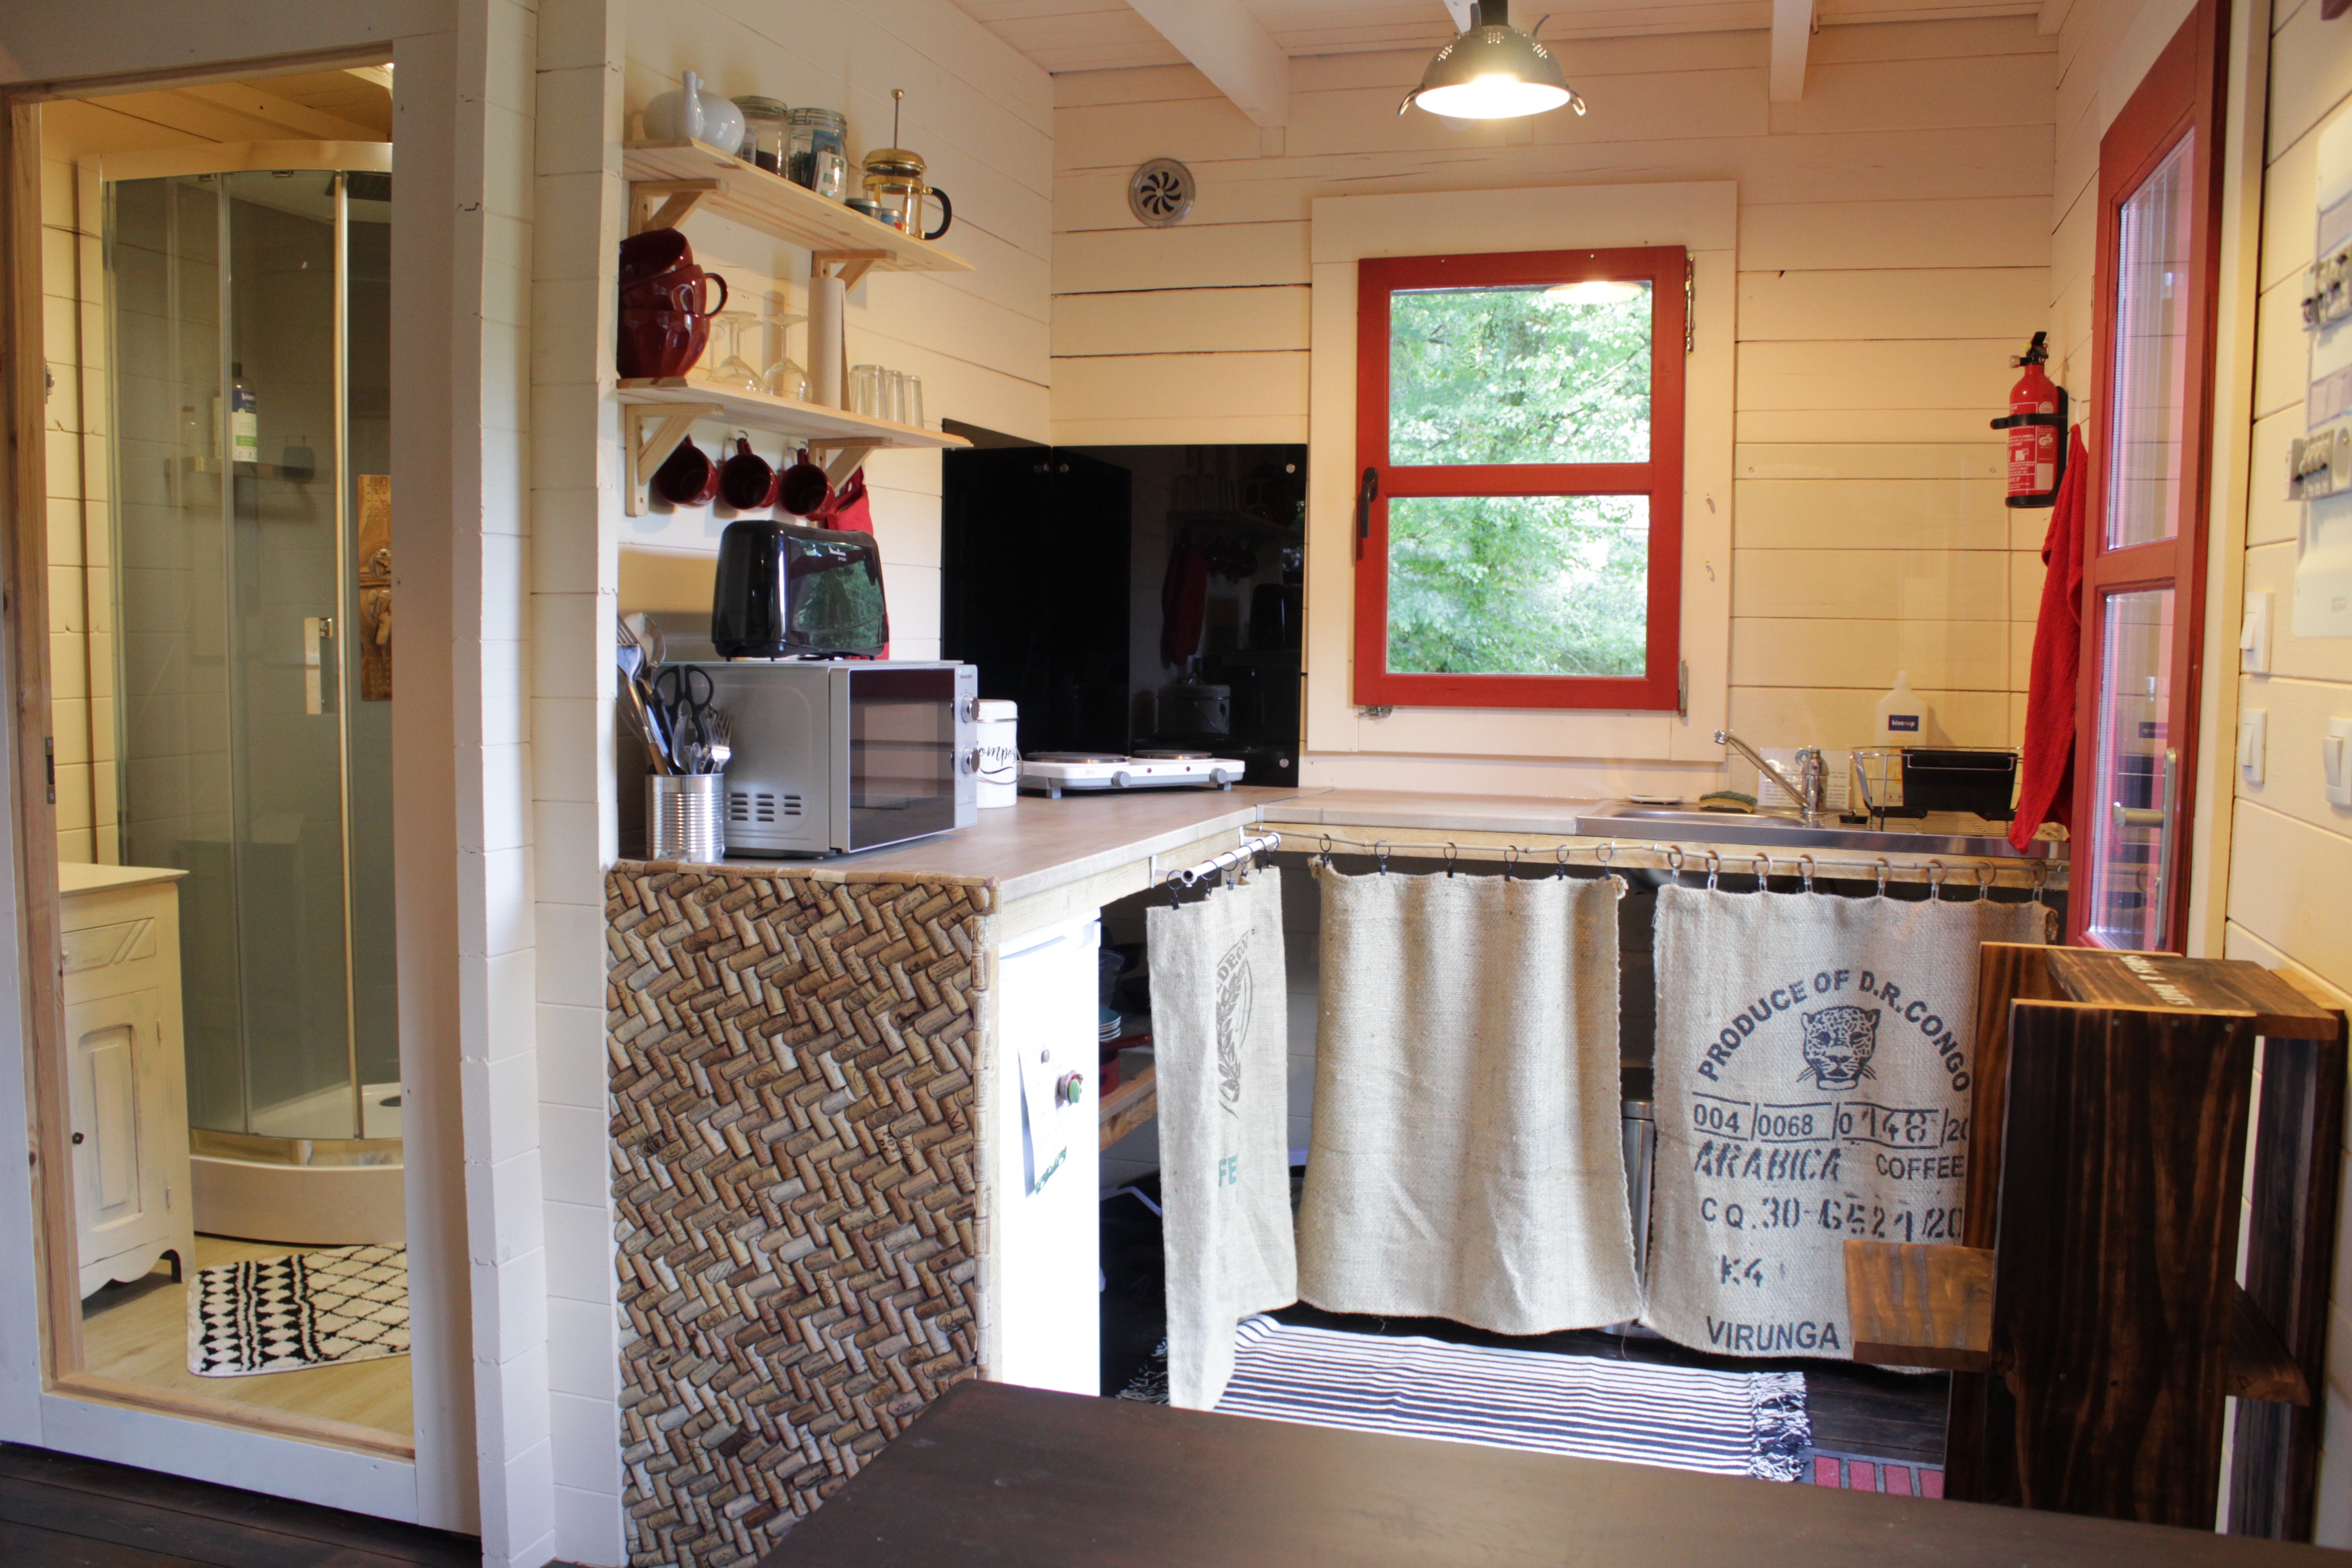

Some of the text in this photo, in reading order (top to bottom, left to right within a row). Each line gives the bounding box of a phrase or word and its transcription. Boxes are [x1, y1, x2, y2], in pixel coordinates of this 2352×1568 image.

[1698, 981, 1808, 1083] PRODUCE
[1814, 970, 1850, 994] OF
[1694, 1104, 1740, 1133] 004
[1758, 1114, 1813, 1136] 0068
[1695, 1140, 1965, 1181] ARABICA COFFEE
[1706, 1316, 1841, 1350] VIRUNGA
